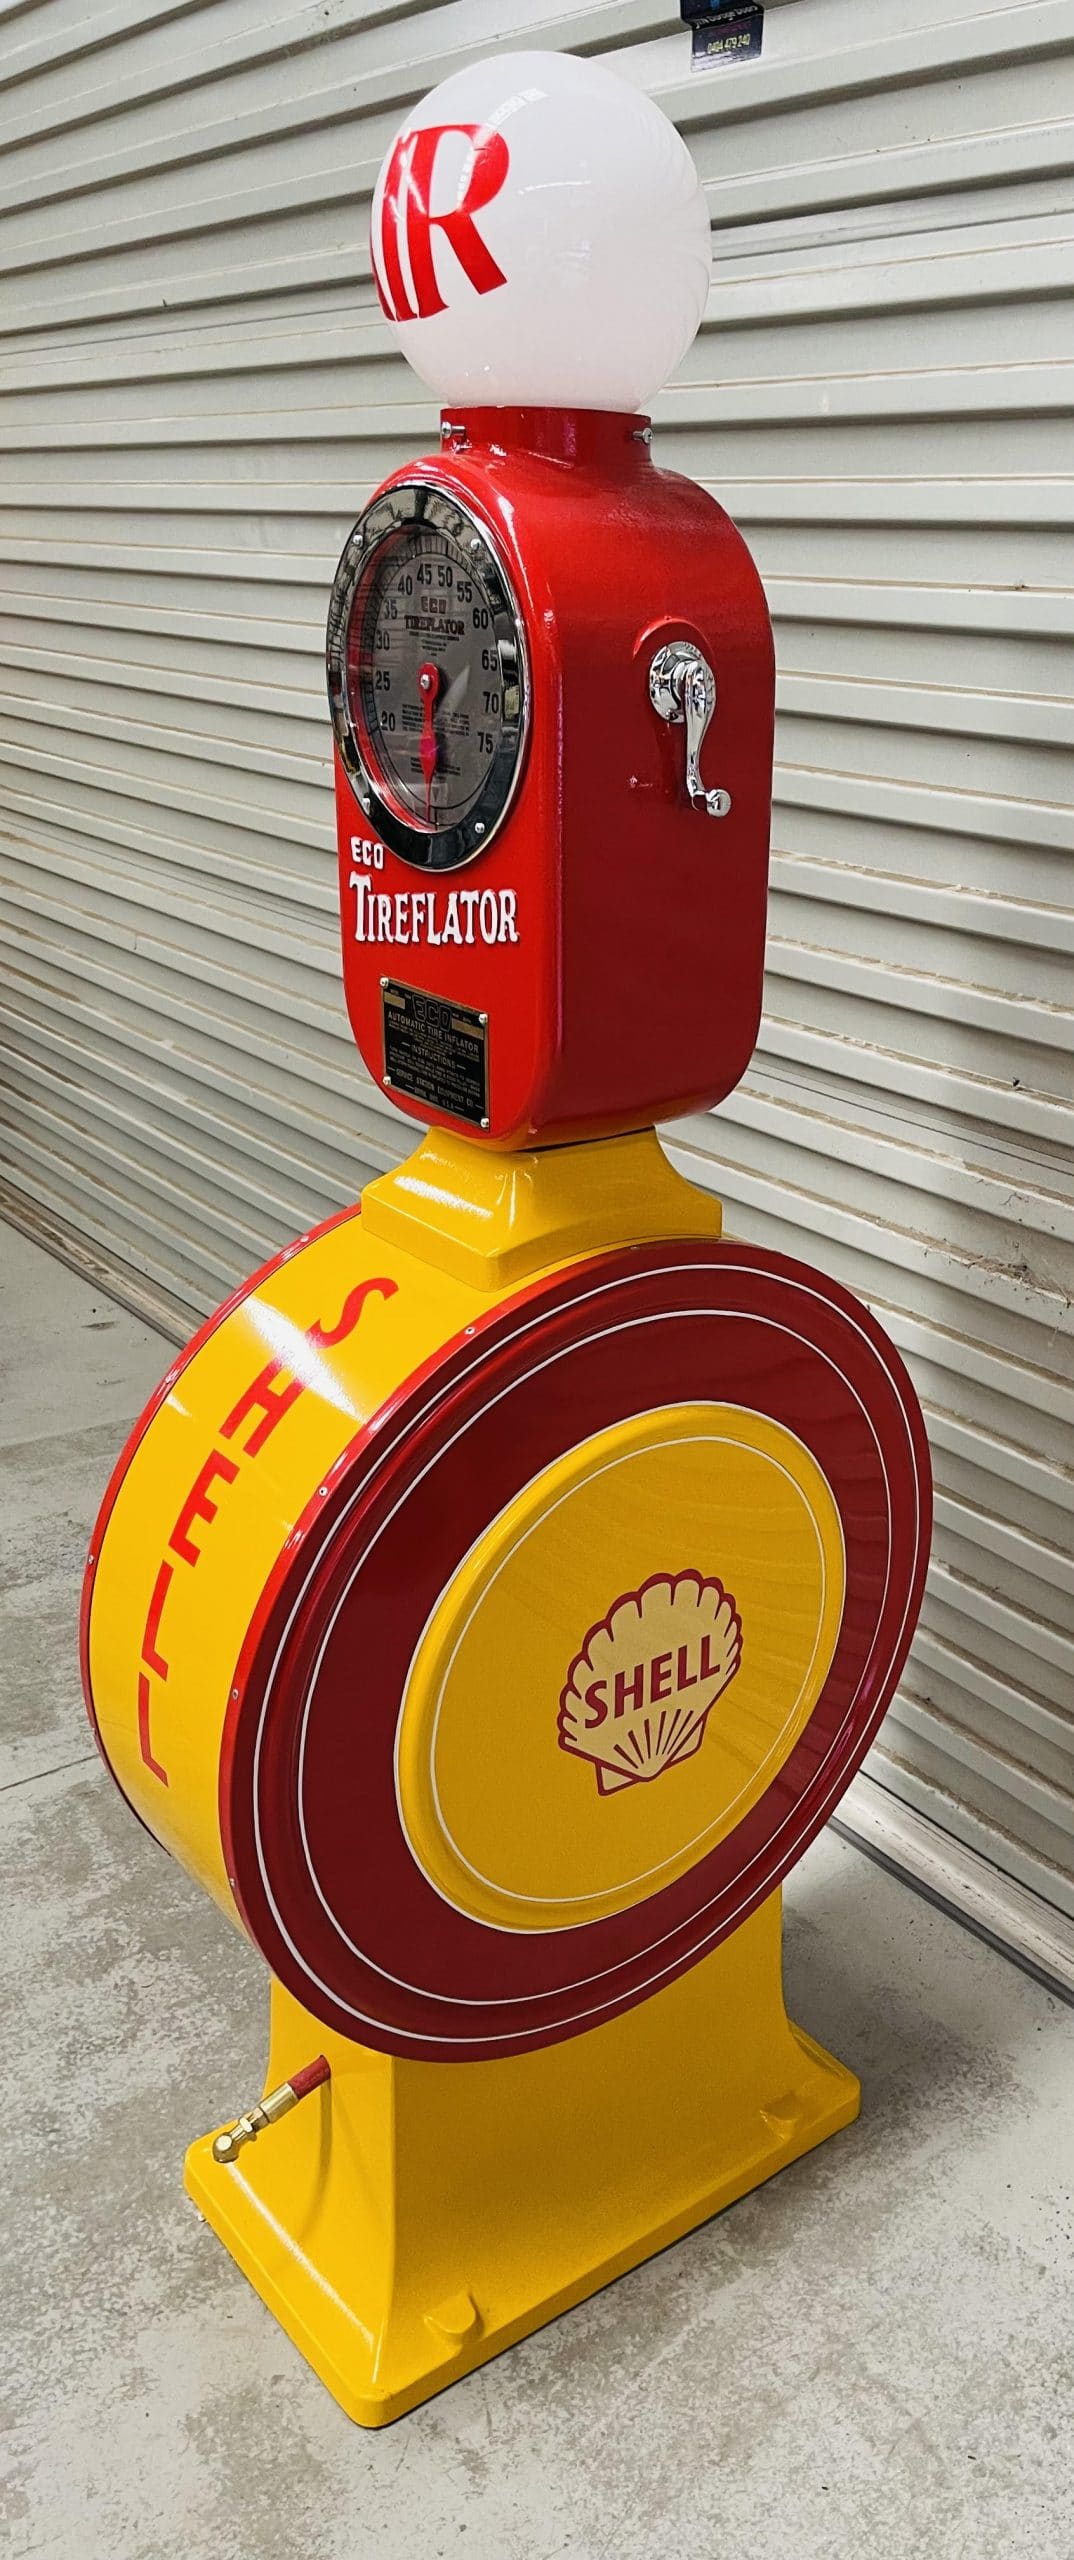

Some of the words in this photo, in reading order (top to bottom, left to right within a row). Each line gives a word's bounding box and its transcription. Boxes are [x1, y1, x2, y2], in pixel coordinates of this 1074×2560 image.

[417, 563, 432, 585] 45
[438, 565, 453, 587] 50
[398, 576, 413, 595] 40
[457, 581, 472, 603] 55
[384, 600, 397, 620] 35
[473, 607, 488, 629] 60
[404, 614, 465, 635] TIREFLATOR
[376, 631, 390, 650] 30
[482, 649, 498, 671] 65
[375, 670, 390, 691] 25
[483, 691, 499, 714] 70
[380, 710, 396, 732] 20
[477, 731, 493, 754] 75
[350, 836, 385, 870] ECO
[349, 870, 519, 945] TIREFLATOR
[412, 993, 452, 1032] ECO
[388, 1010, 426, 1033] AUTOMATIC
[427, 1025, 443, 1040] TIRE
[444, 1031, 479, 1054] INFLATOR
[138, 1277, 399, 1787] SHELL
[584, 1634, 721, 1729] SHELL
